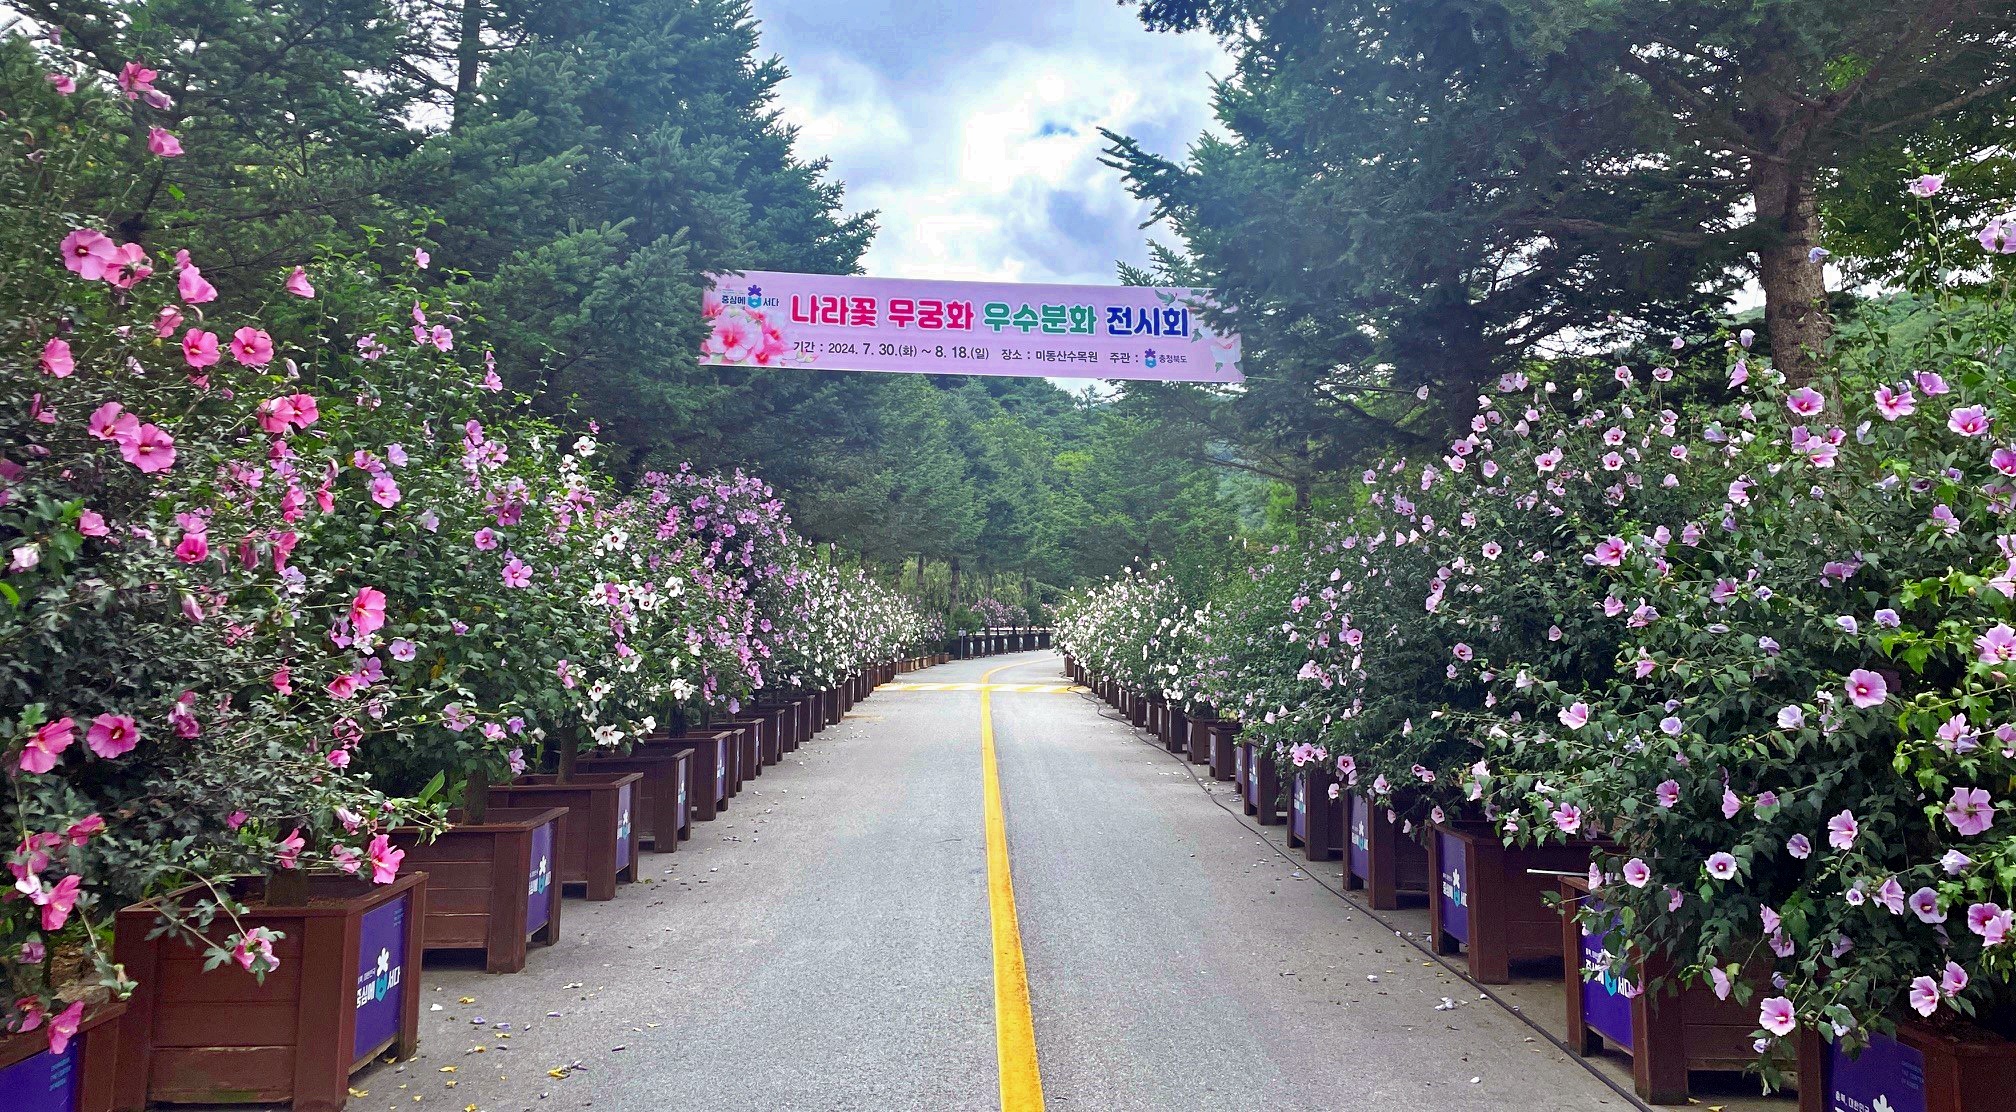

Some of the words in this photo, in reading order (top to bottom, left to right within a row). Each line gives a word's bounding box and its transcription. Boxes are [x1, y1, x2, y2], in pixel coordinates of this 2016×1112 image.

[721, 295, 746, 305] 중심에
[763, 297, 780, 307] 서다
[791, 294, 877, 327] 나라꽃
[888, 298, 975, 331] 무궁화
[984, 301, 1098, 335] 우수분화
[1106, 305, 1189, 338] 전시회
[793, 341, 815, 353] 기간
[828, 342, 859, 355] 2024.
[862, 342, 874, 356] 7.
[878, 343, 917, 358] 30.(화)
[934, 345, 947, 359] 8.
[951, 346, 990, 360] 18.(일)
[1001, 348, 1023, 361] 장소
[1035, 350, 1099, 363] 미동산수목원
[1109, 352, 1131, 364] 주관
[1158, 353, 1188, 364] 충청북도
